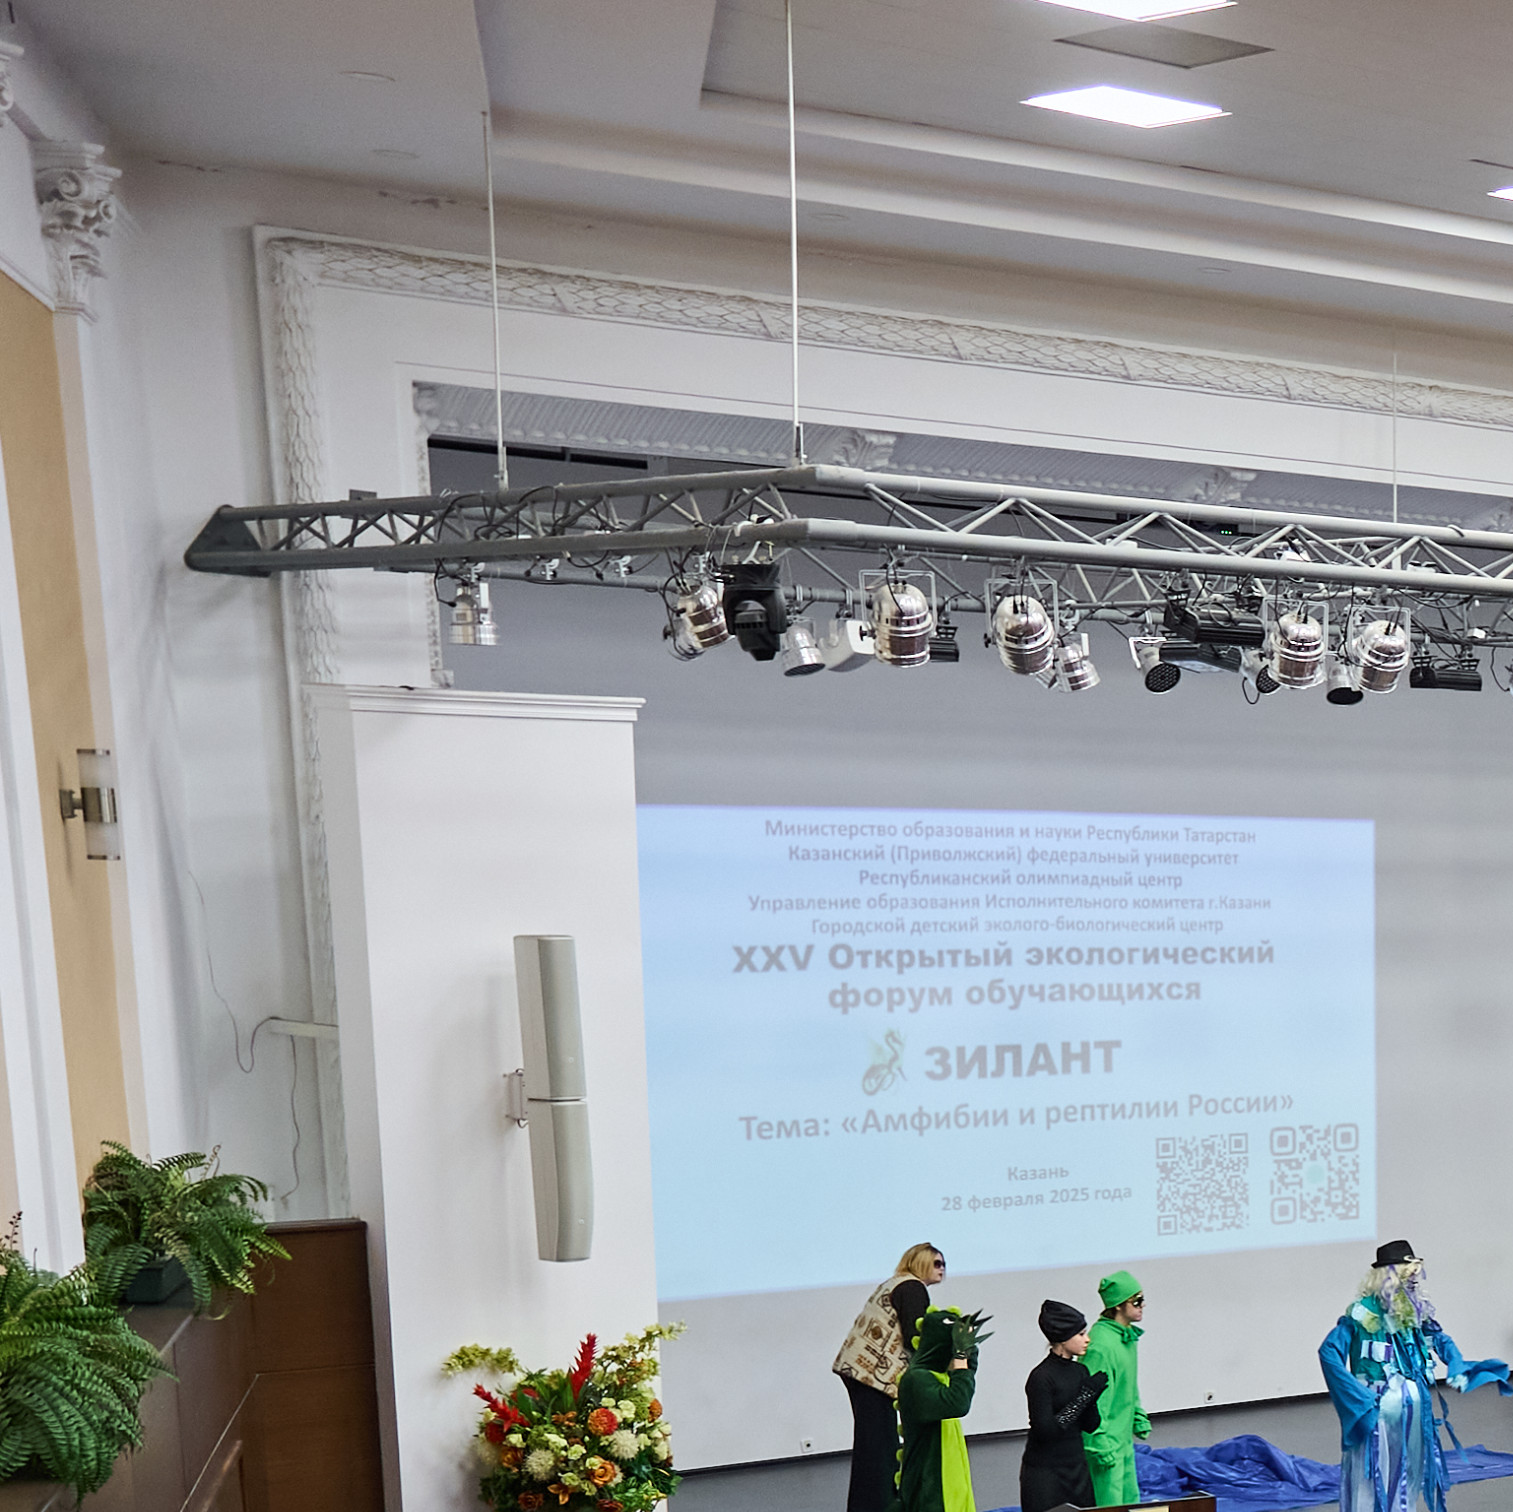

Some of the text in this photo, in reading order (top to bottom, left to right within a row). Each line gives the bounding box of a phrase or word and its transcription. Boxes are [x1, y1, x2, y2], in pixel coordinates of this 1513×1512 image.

[765, 819, 1256, 845] Министерство образования и науки Республики Татарстан
[789, 845, 1238, 867] Казанский (Приволжский) федеральный университет
[859, 869, 1182, 890] Республиканский олимпиадный центр
[748, 896, 861, 912] Управление
[867, 893, 980, 911] образования
[985, 894, 1128, 909] Исполнительного
[1133, 897, 1204, 909] комитета
[811, 915, 1223, 936] Городской детский эколого-биологический центр
[733, 938, 1274, 975] XXV Открытый экологический
[828, 977, 1201, 1015] форум обучающихся
[924, 1040, 1122, 1081] ЗИЛАНТ
[739, 1093, 1294, 1141] Тема: «Амфибии и рептилии России»
[1007, 1164, 1069, 1181] Казань
[941, 1186, 1132, 1212] 28 февраля 2025 года
